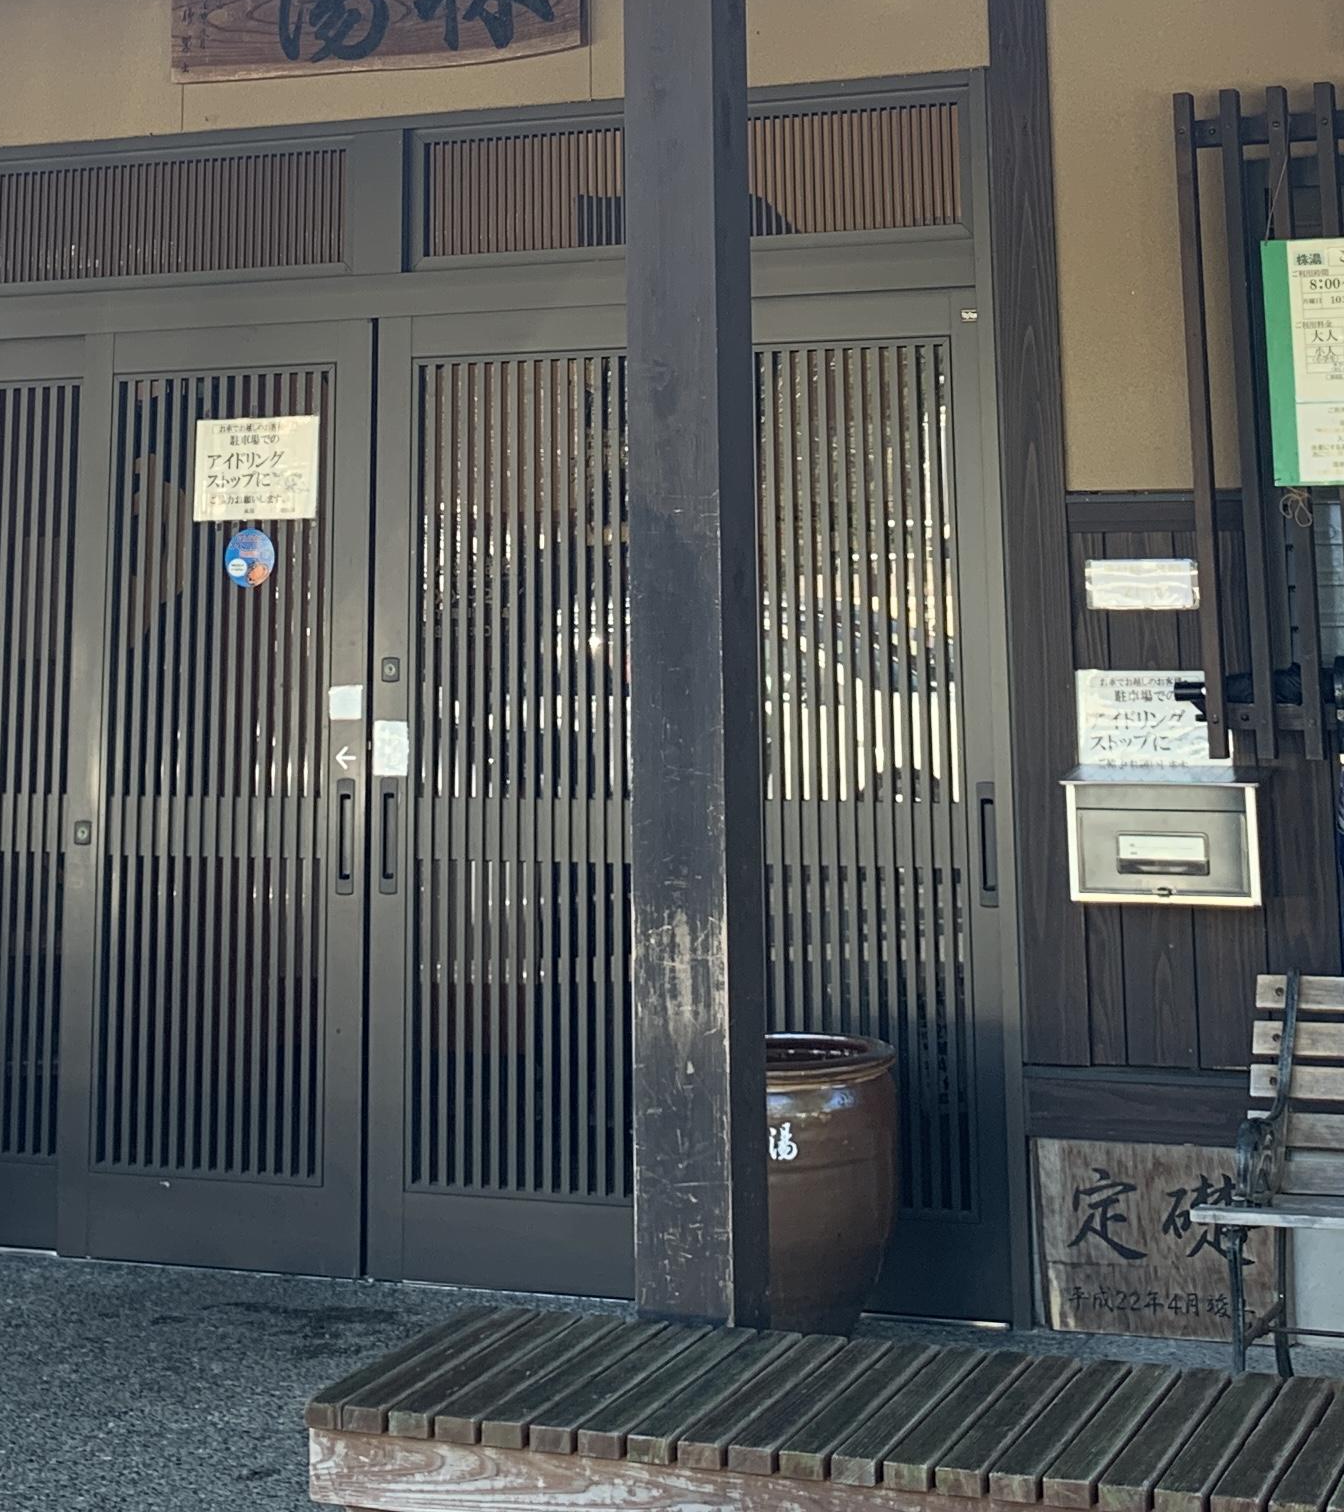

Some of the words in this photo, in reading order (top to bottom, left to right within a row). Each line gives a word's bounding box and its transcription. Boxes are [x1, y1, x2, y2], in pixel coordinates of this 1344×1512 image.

[208, 451, 285, 470] アイドリング
[208, 472, 271, 489] ストップに
[1091, 710, 1186, 729] アイドリング
[1091, 734, 1171, 752] ストップに
[768, 1122, 798, 1161] 湯
[1067, 1167, 1256, 1266] 定礎
[1068, 1286, 1256, 1330] 平成22年4月竣
